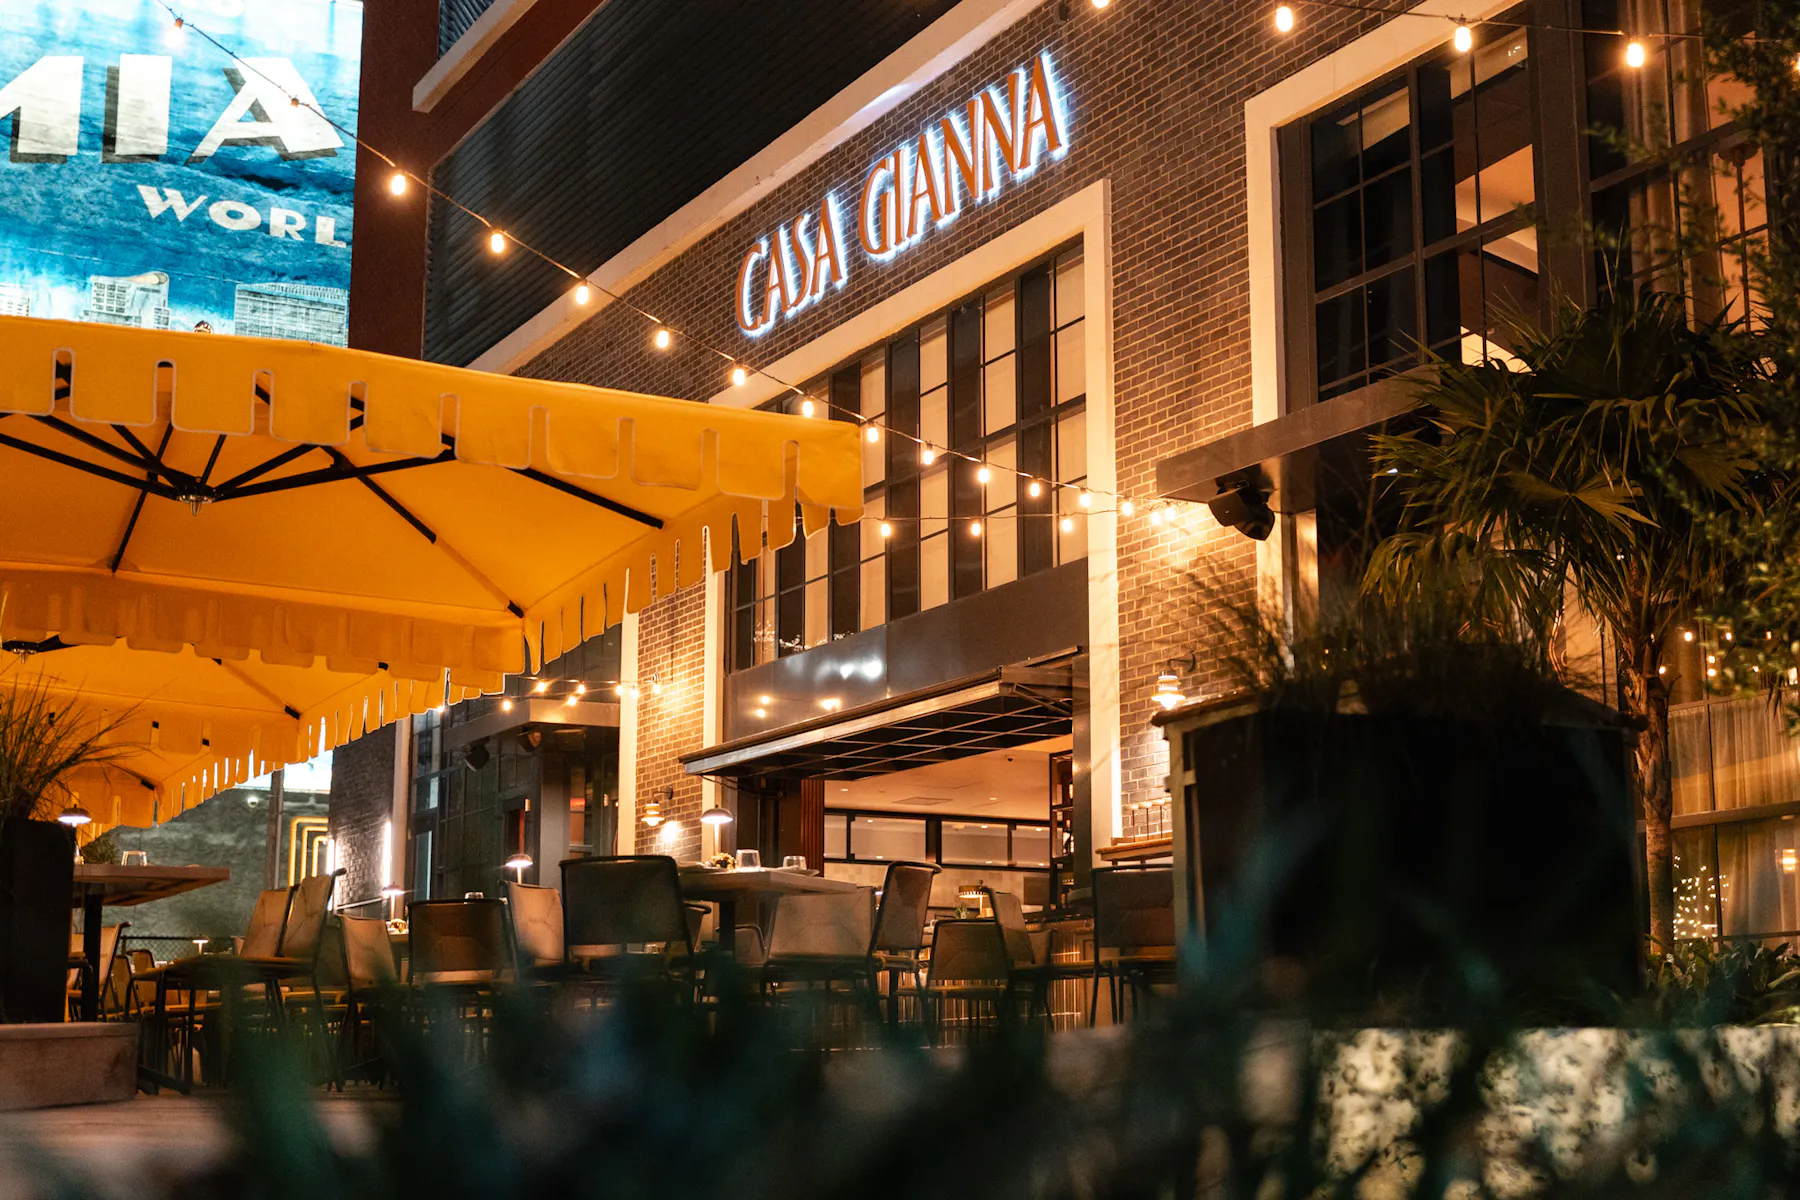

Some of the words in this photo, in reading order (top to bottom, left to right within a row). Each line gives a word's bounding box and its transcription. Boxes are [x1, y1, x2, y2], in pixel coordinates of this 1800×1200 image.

[137, 185, 347, 248] WORL
[735, 199, 843, 331] CASA
[858, 55, 1063, 255] GIANNA
